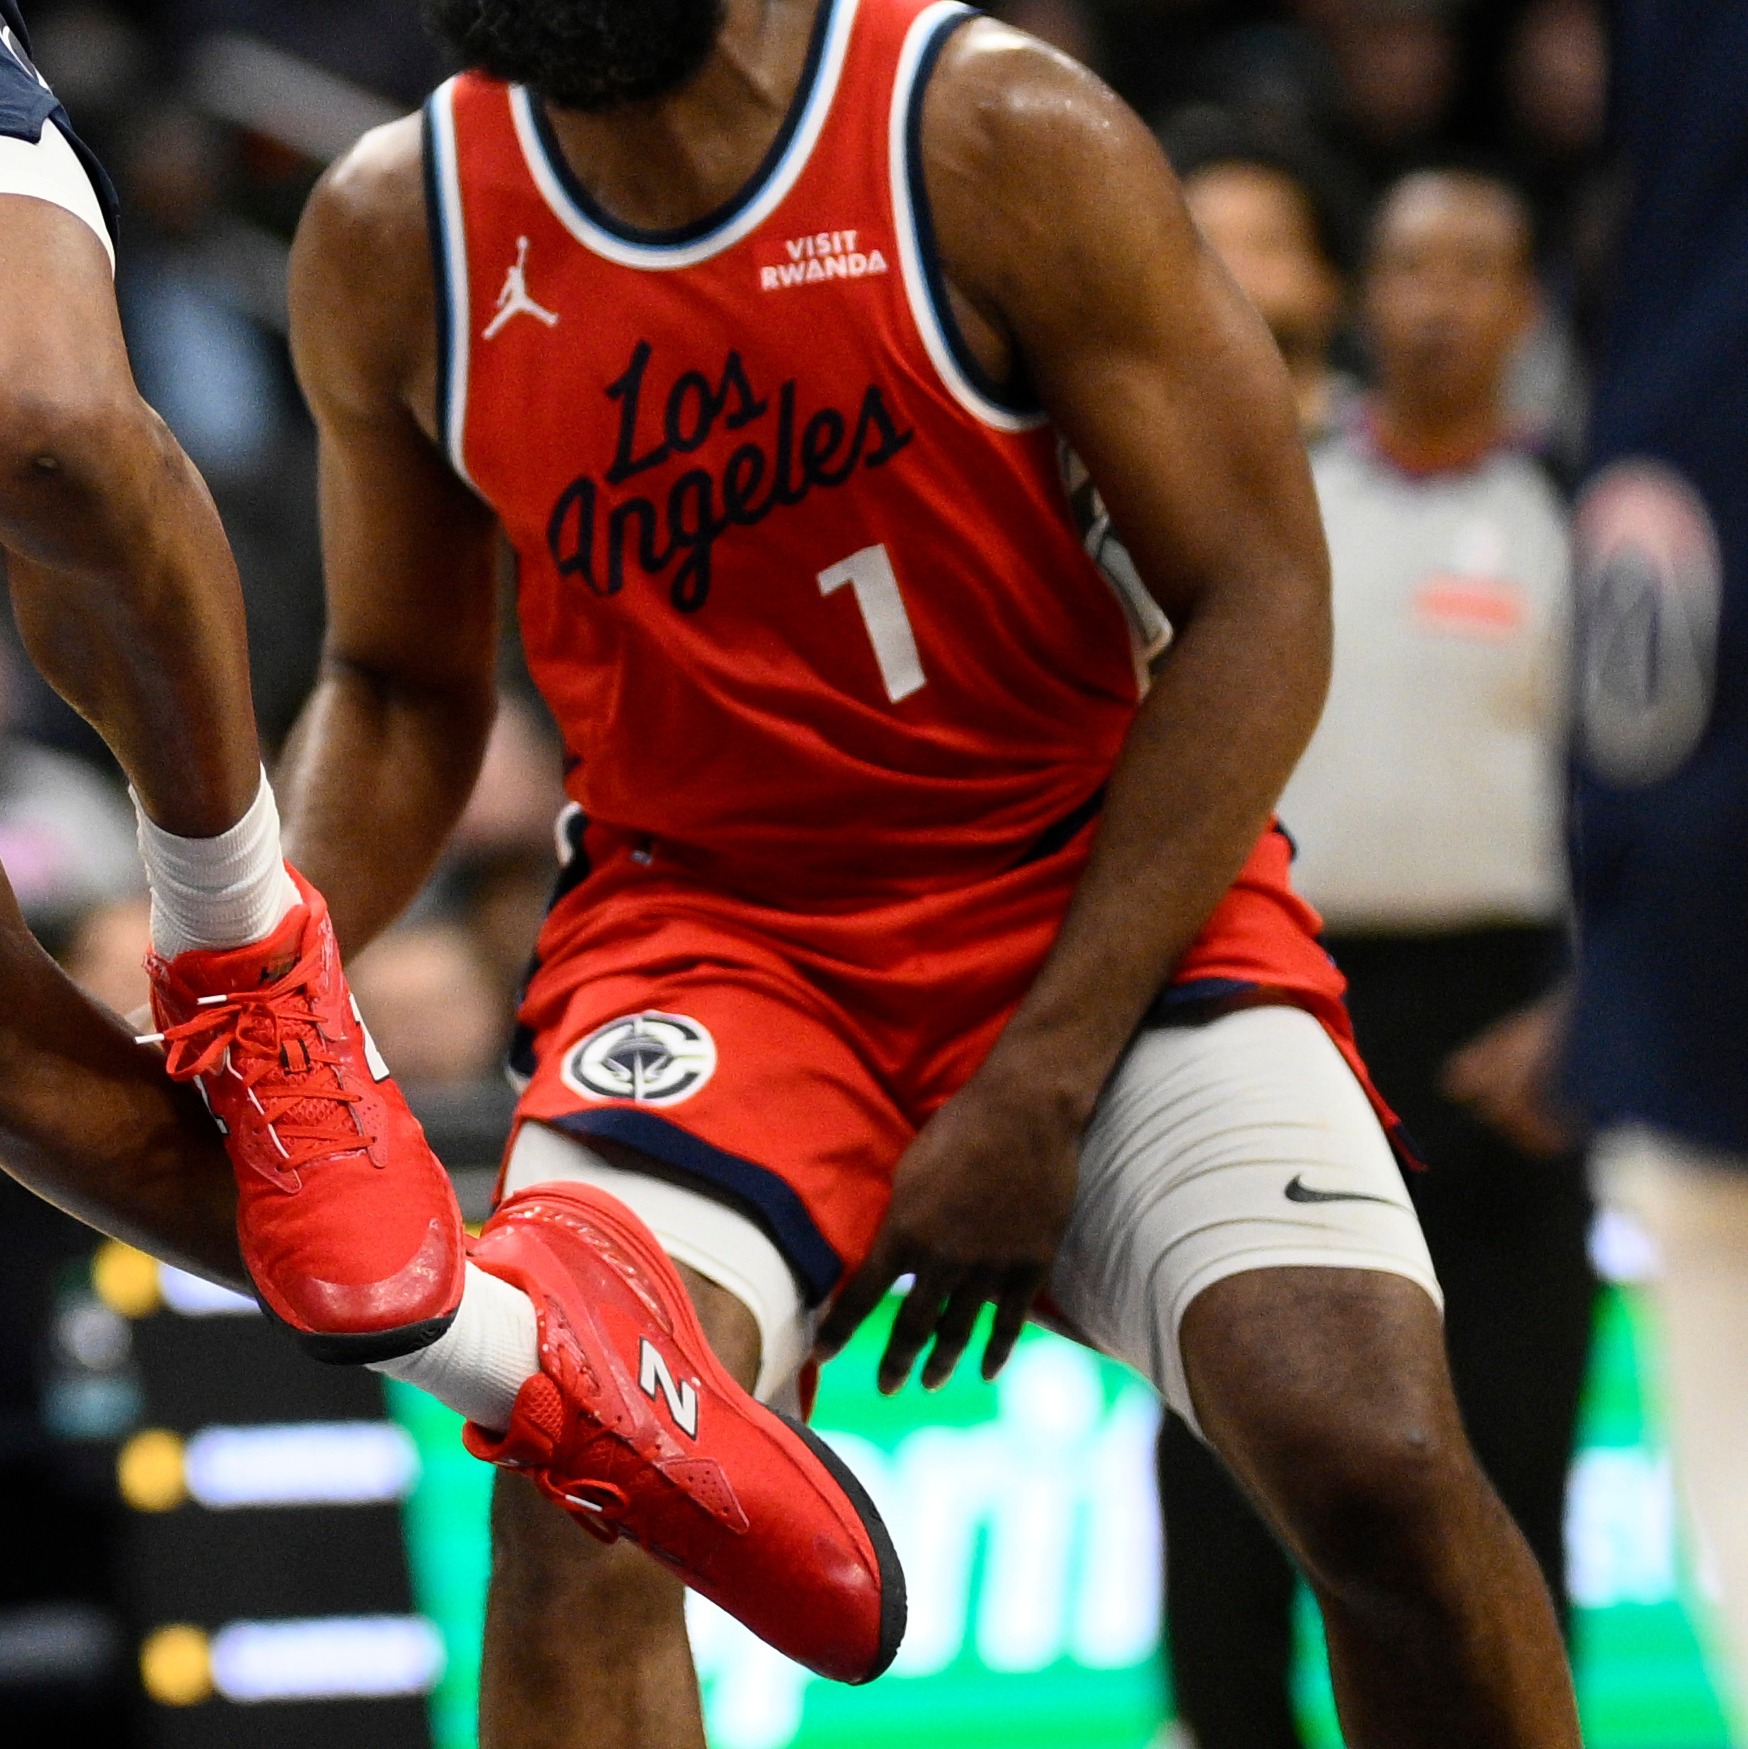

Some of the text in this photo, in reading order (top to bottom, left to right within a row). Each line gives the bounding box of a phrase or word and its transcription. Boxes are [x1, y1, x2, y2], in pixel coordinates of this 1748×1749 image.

[760, 249, 889, 291] RWANDA
[785, 229, 858, 260] VISIT
[605, 339, 769, 485] Los
[546, 379, 916, 614] Angeles
[816, 542, 928, 705] 1
